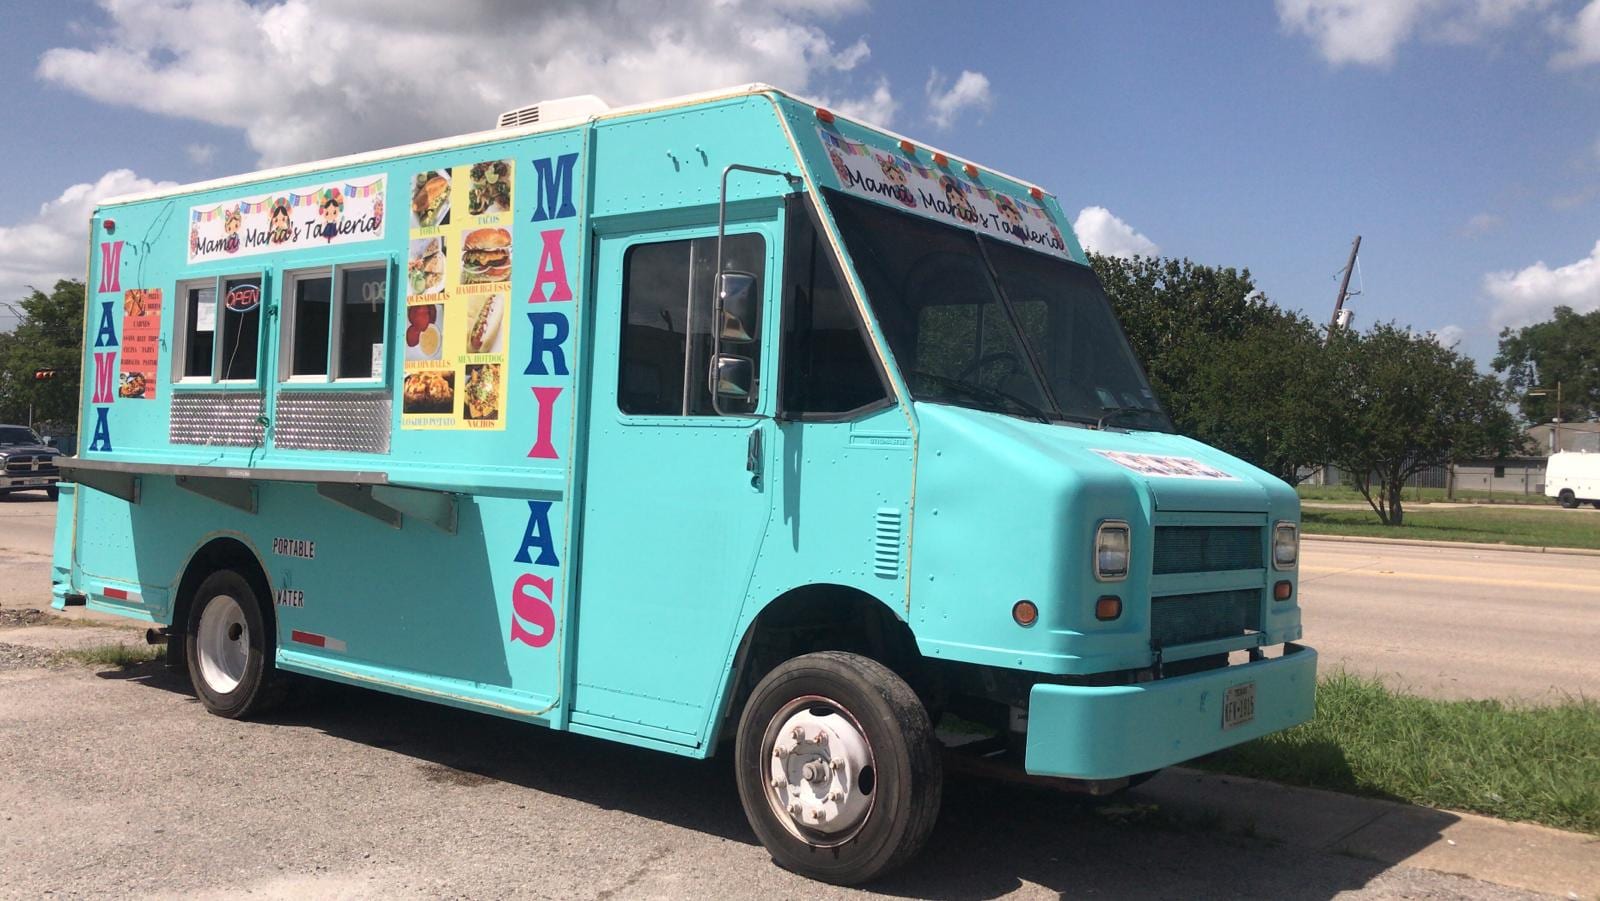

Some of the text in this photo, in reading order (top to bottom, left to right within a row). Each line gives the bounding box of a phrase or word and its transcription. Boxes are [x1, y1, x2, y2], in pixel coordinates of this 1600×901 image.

[478, 215, 499, 225] TACOS
[420, 226, 440, 236] TORTA
[456, 283, 512, 296] HAMBURGUESAS
[227, 289, 259, 305] OPEN
[406, 292, 450, 305] QUESADILLAS
[89, 241, 124, 451] MAMA
[467, 419, 495, 429] NACHOS
[273, 537, 314, 558] PORTABLE
